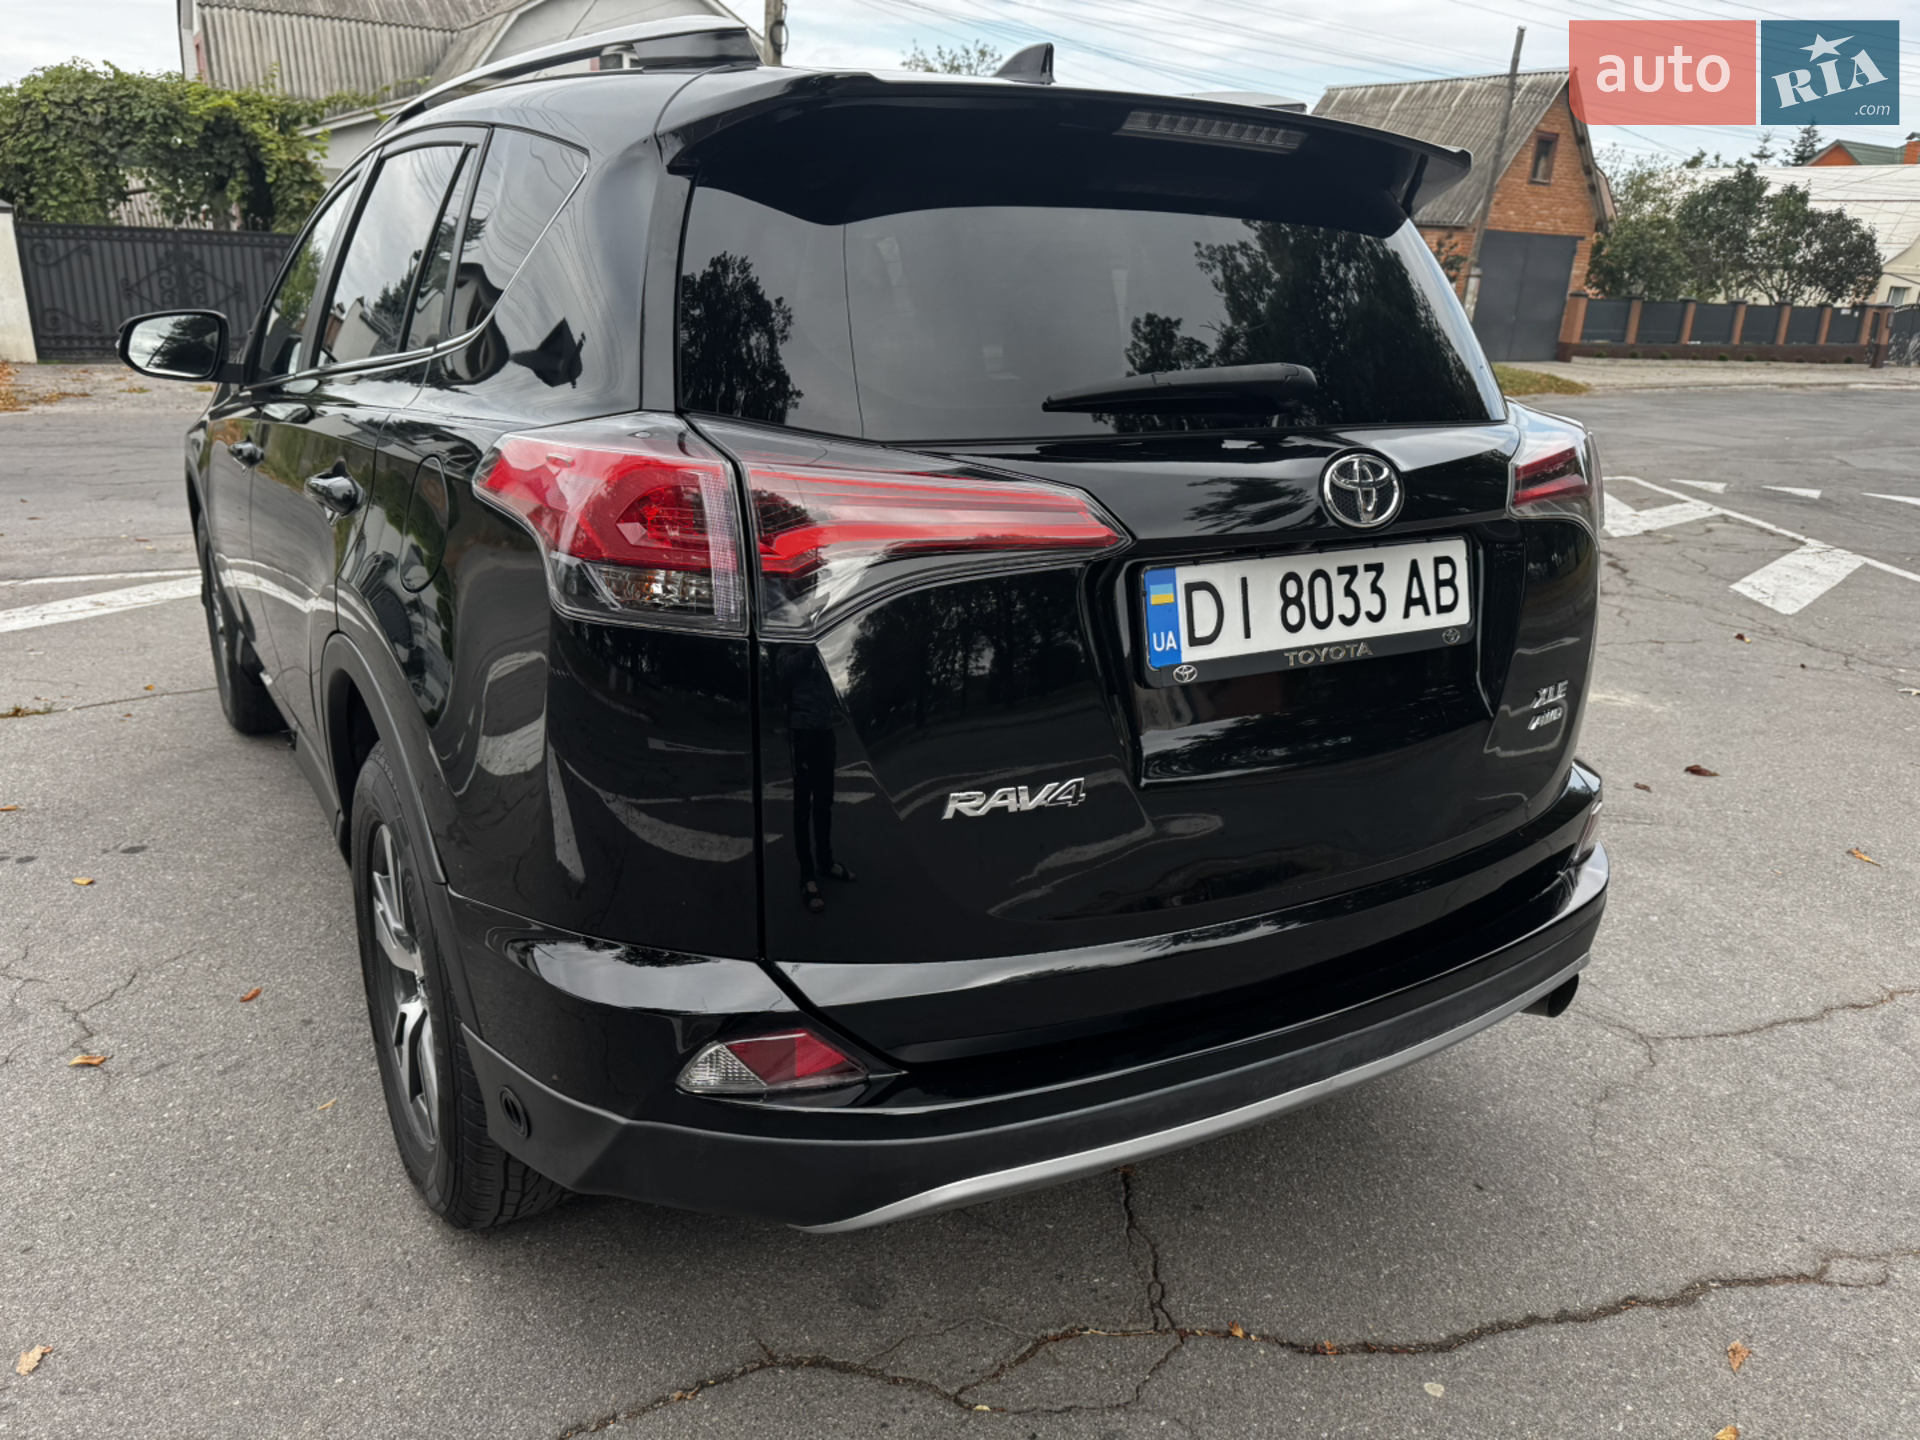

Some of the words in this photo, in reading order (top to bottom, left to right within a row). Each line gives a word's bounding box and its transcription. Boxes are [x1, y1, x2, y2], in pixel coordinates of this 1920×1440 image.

[1184, 576, 1251, 647] DI
[1279, 562, 1387, 634] 8033
[1402, 555, 1460, 620] AB
[1152, 630, 1178, 652] UA
[1284, 642, 1373, 667] TOYOTA
[1531, 680, 1569, 709] XLE
[941, 777, 1087, 821] RAV4
